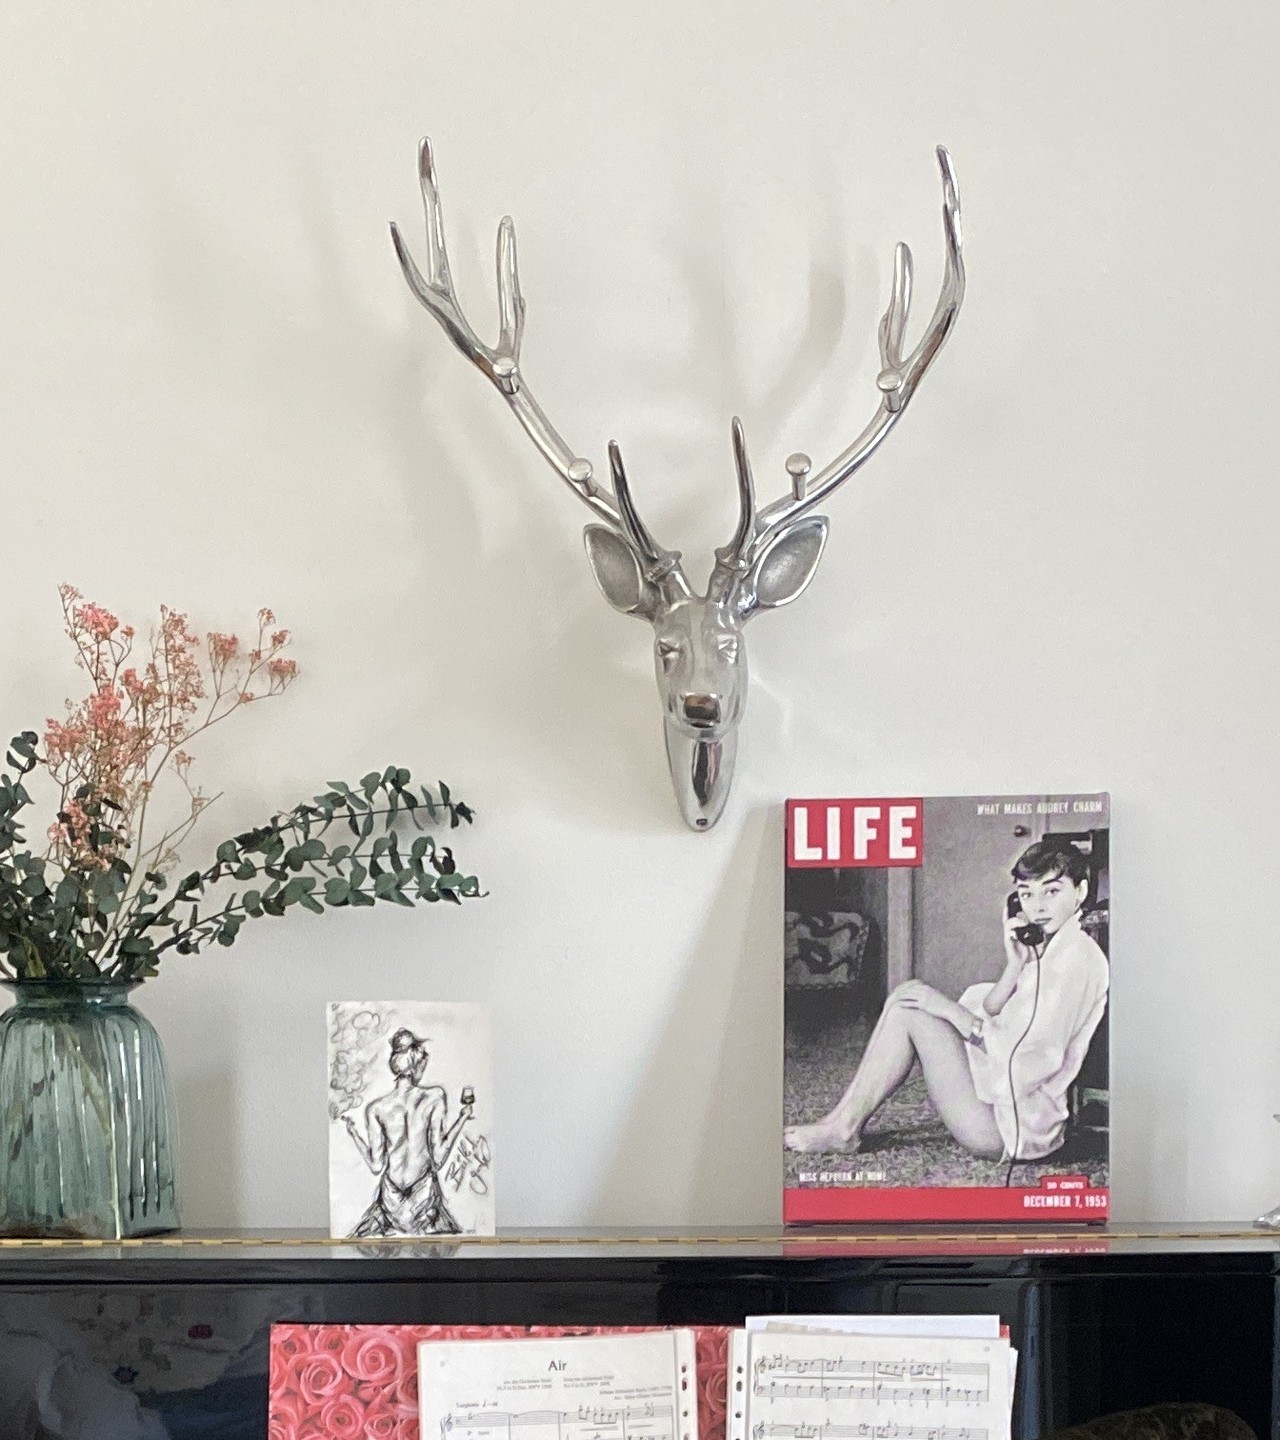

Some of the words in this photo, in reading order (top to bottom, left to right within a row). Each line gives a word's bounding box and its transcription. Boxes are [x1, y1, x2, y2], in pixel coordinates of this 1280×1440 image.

[977, 804, 1000, 815] WHAT
[1004, 803, 1032, 814] MAKES
[1036, 802, 1069, 814] AUDREY
[1073, 801, 1103, 812] CHARM
[792, 805, 917, 861] LIFE
[799, 1172, 817, 1182] MISS
[819, 1172, 853, 1182] HEPBURN
[855, 1171, 864, 1181] AT
[867, 1171, 887, 1181] HOME
[1059, 1181, 1084, 1190] CENTS
[1023, 1195, 1072, 1208] DECEMBER
[1075, 1196, 1084, 1209] 7,
[1085, 1194, 1107, 1208] 1953
[548, 1360, 567, 1372] Air
